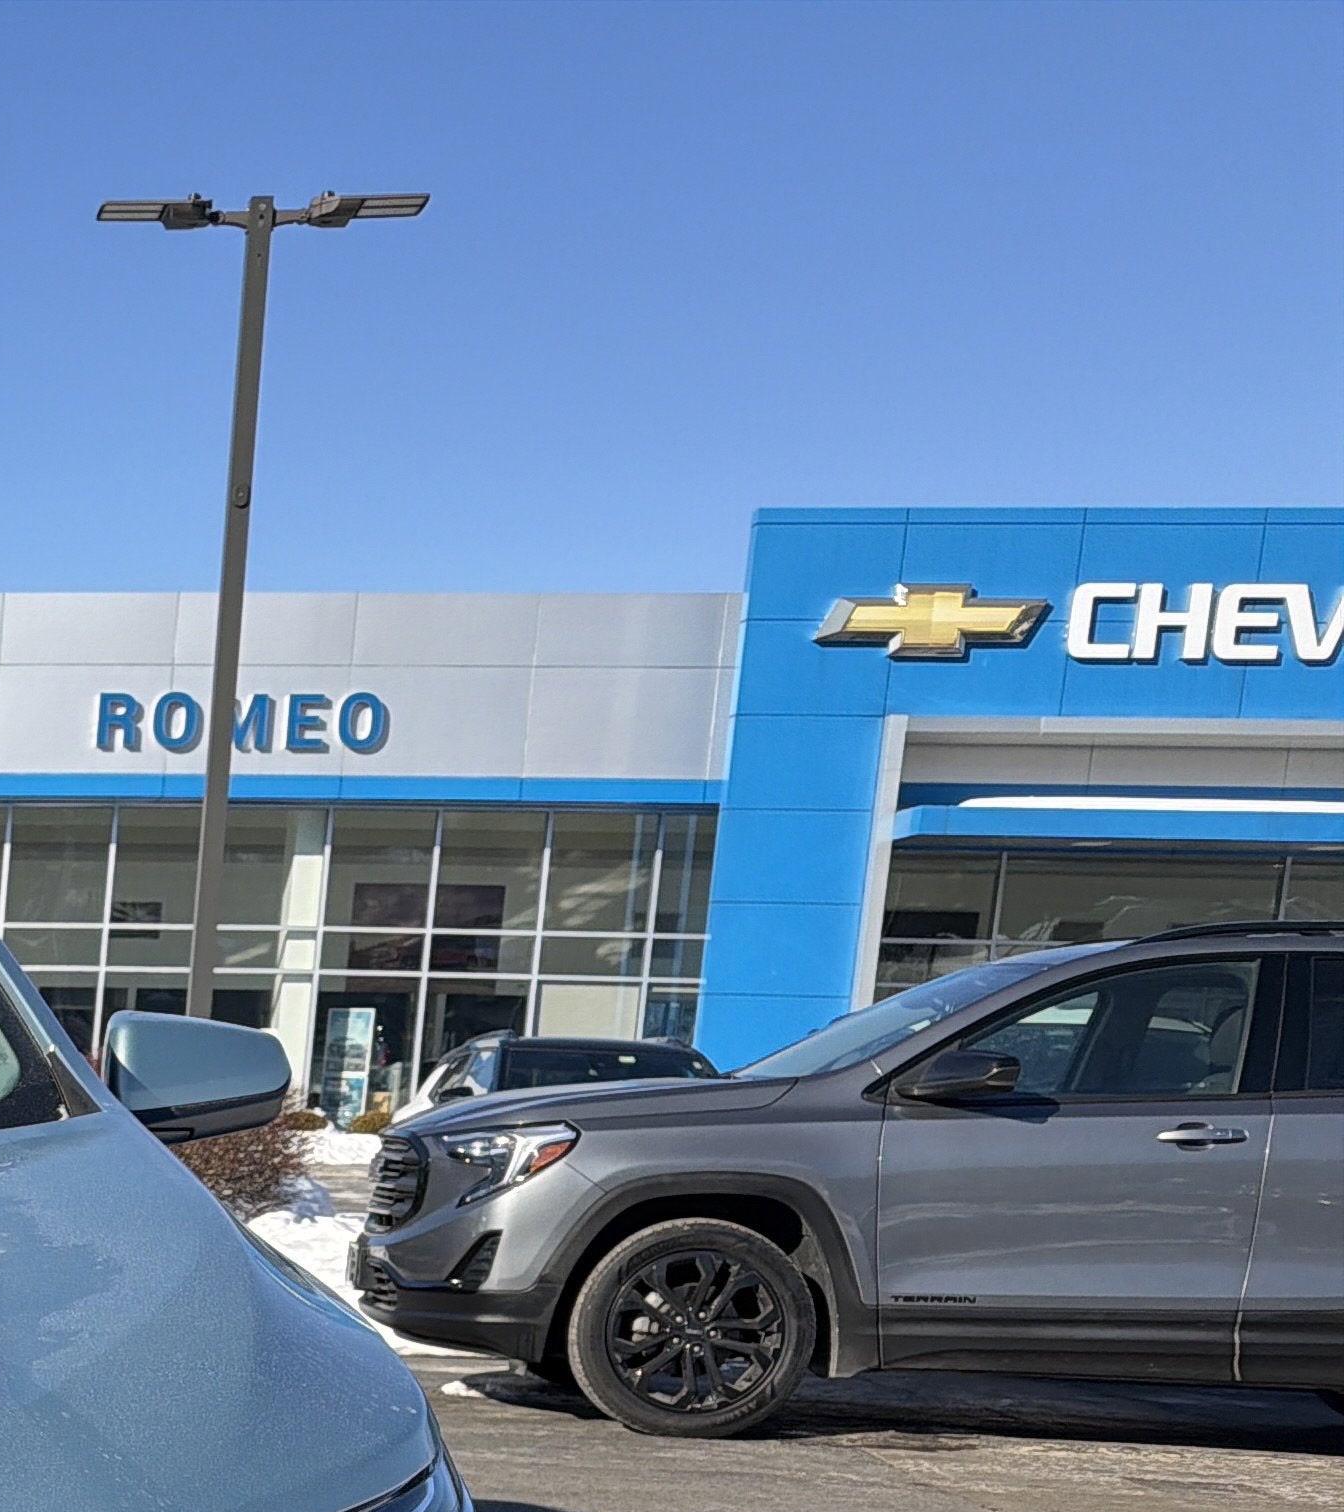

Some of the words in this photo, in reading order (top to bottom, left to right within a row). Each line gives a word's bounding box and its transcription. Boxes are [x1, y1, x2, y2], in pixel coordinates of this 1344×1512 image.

[1067, 582, 1344, 661] CHEV
[96, 691, 389, 752] ROMEO
[891, 1295, 977, 1304] TERRAIN
